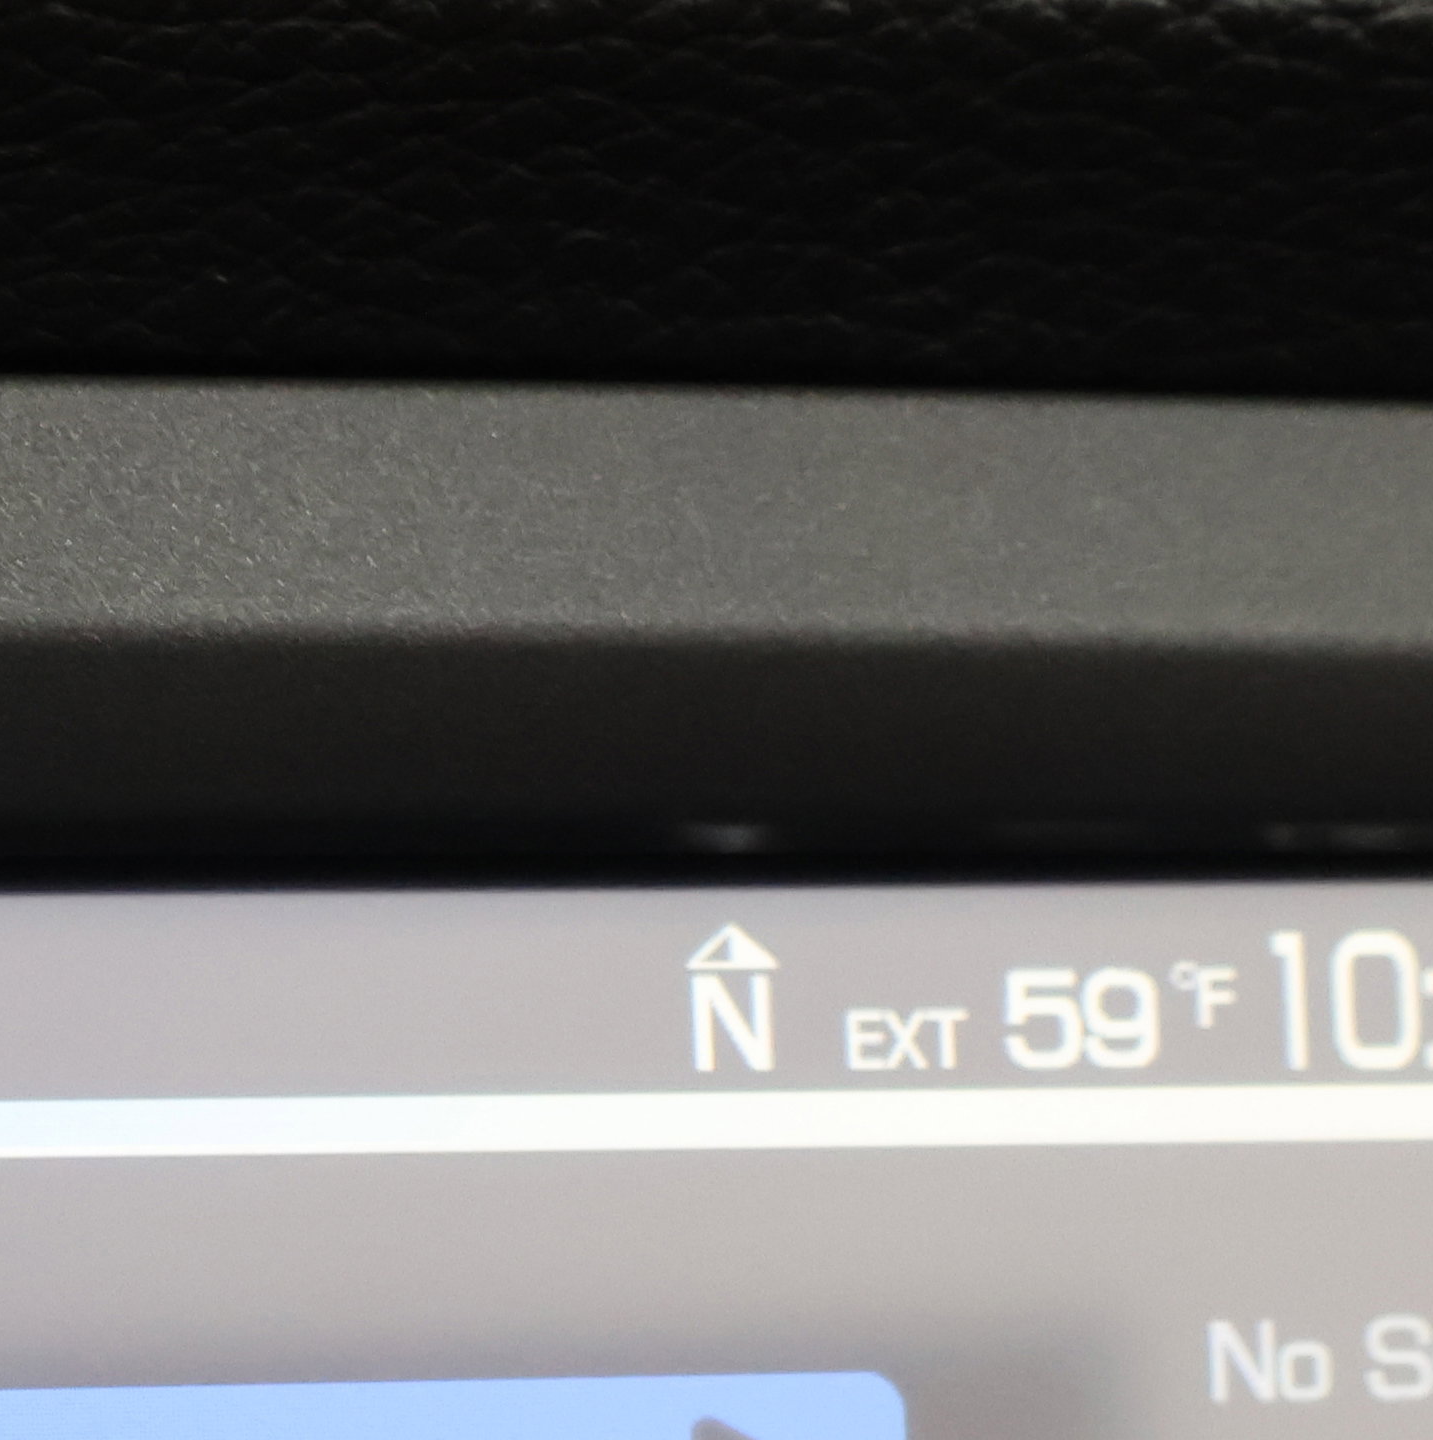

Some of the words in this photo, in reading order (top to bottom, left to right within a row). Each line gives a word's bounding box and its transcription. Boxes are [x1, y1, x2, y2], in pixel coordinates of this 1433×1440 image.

[691, 973, 774, 1071] N
[845, 1010, 967, 1069] EXT
[1209, 1319, 1330, 1402] No
